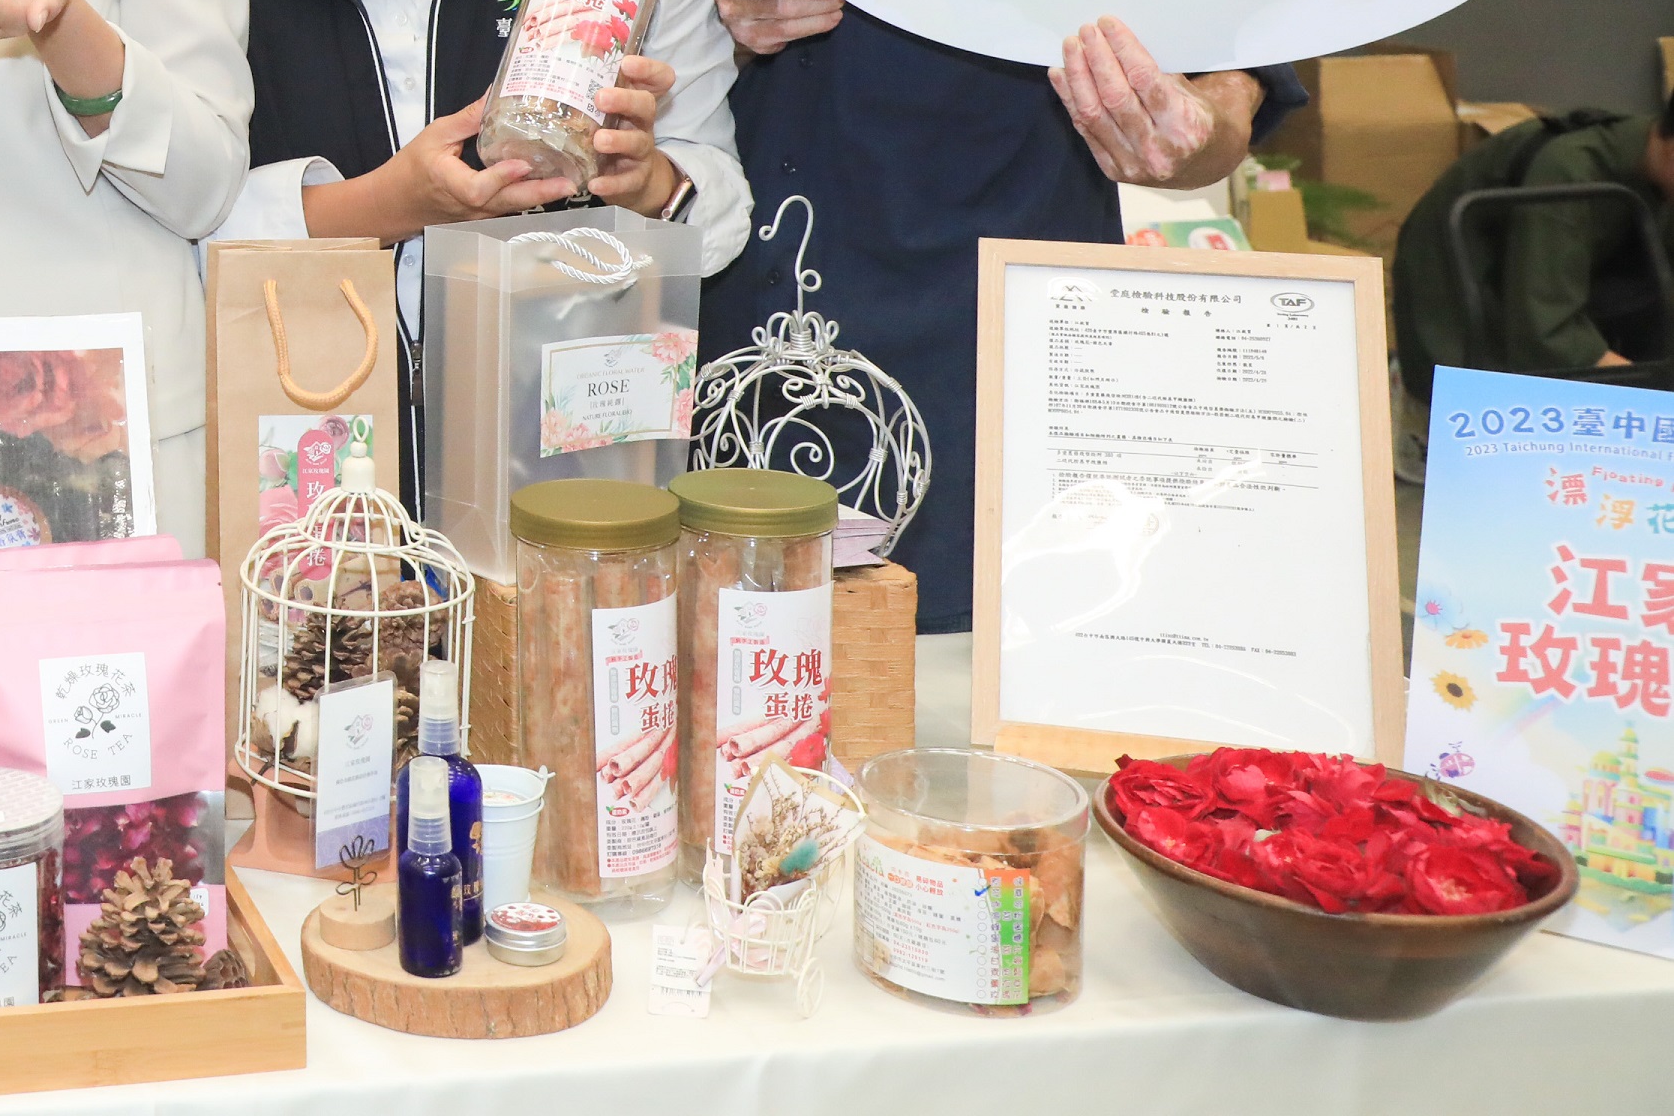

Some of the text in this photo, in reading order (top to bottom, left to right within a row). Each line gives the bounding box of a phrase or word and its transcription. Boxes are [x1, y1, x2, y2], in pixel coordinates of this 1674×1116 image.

[1279, 297, 1307, 307] TAF
[587, 379, 631, 397] ROSE
[1466, 443, 1498, 456] 2023
[1503, 441, 1565, 453] Taichung
[1569, 442, 1663, 461] International
[748, 648, 823, 689] 玫瑰
[56, 663, 136, 699] 乾燥玫瑰花茶
[640, 700, 675, 732] 蛋捲
[765, 691, 813, 721] 蛋捲
[63, 734, 133, 759] ROSE TEA
[72, 774, 131, 790] 江家玫瑰園
[0, 932, 27, 942] MIRACLE
